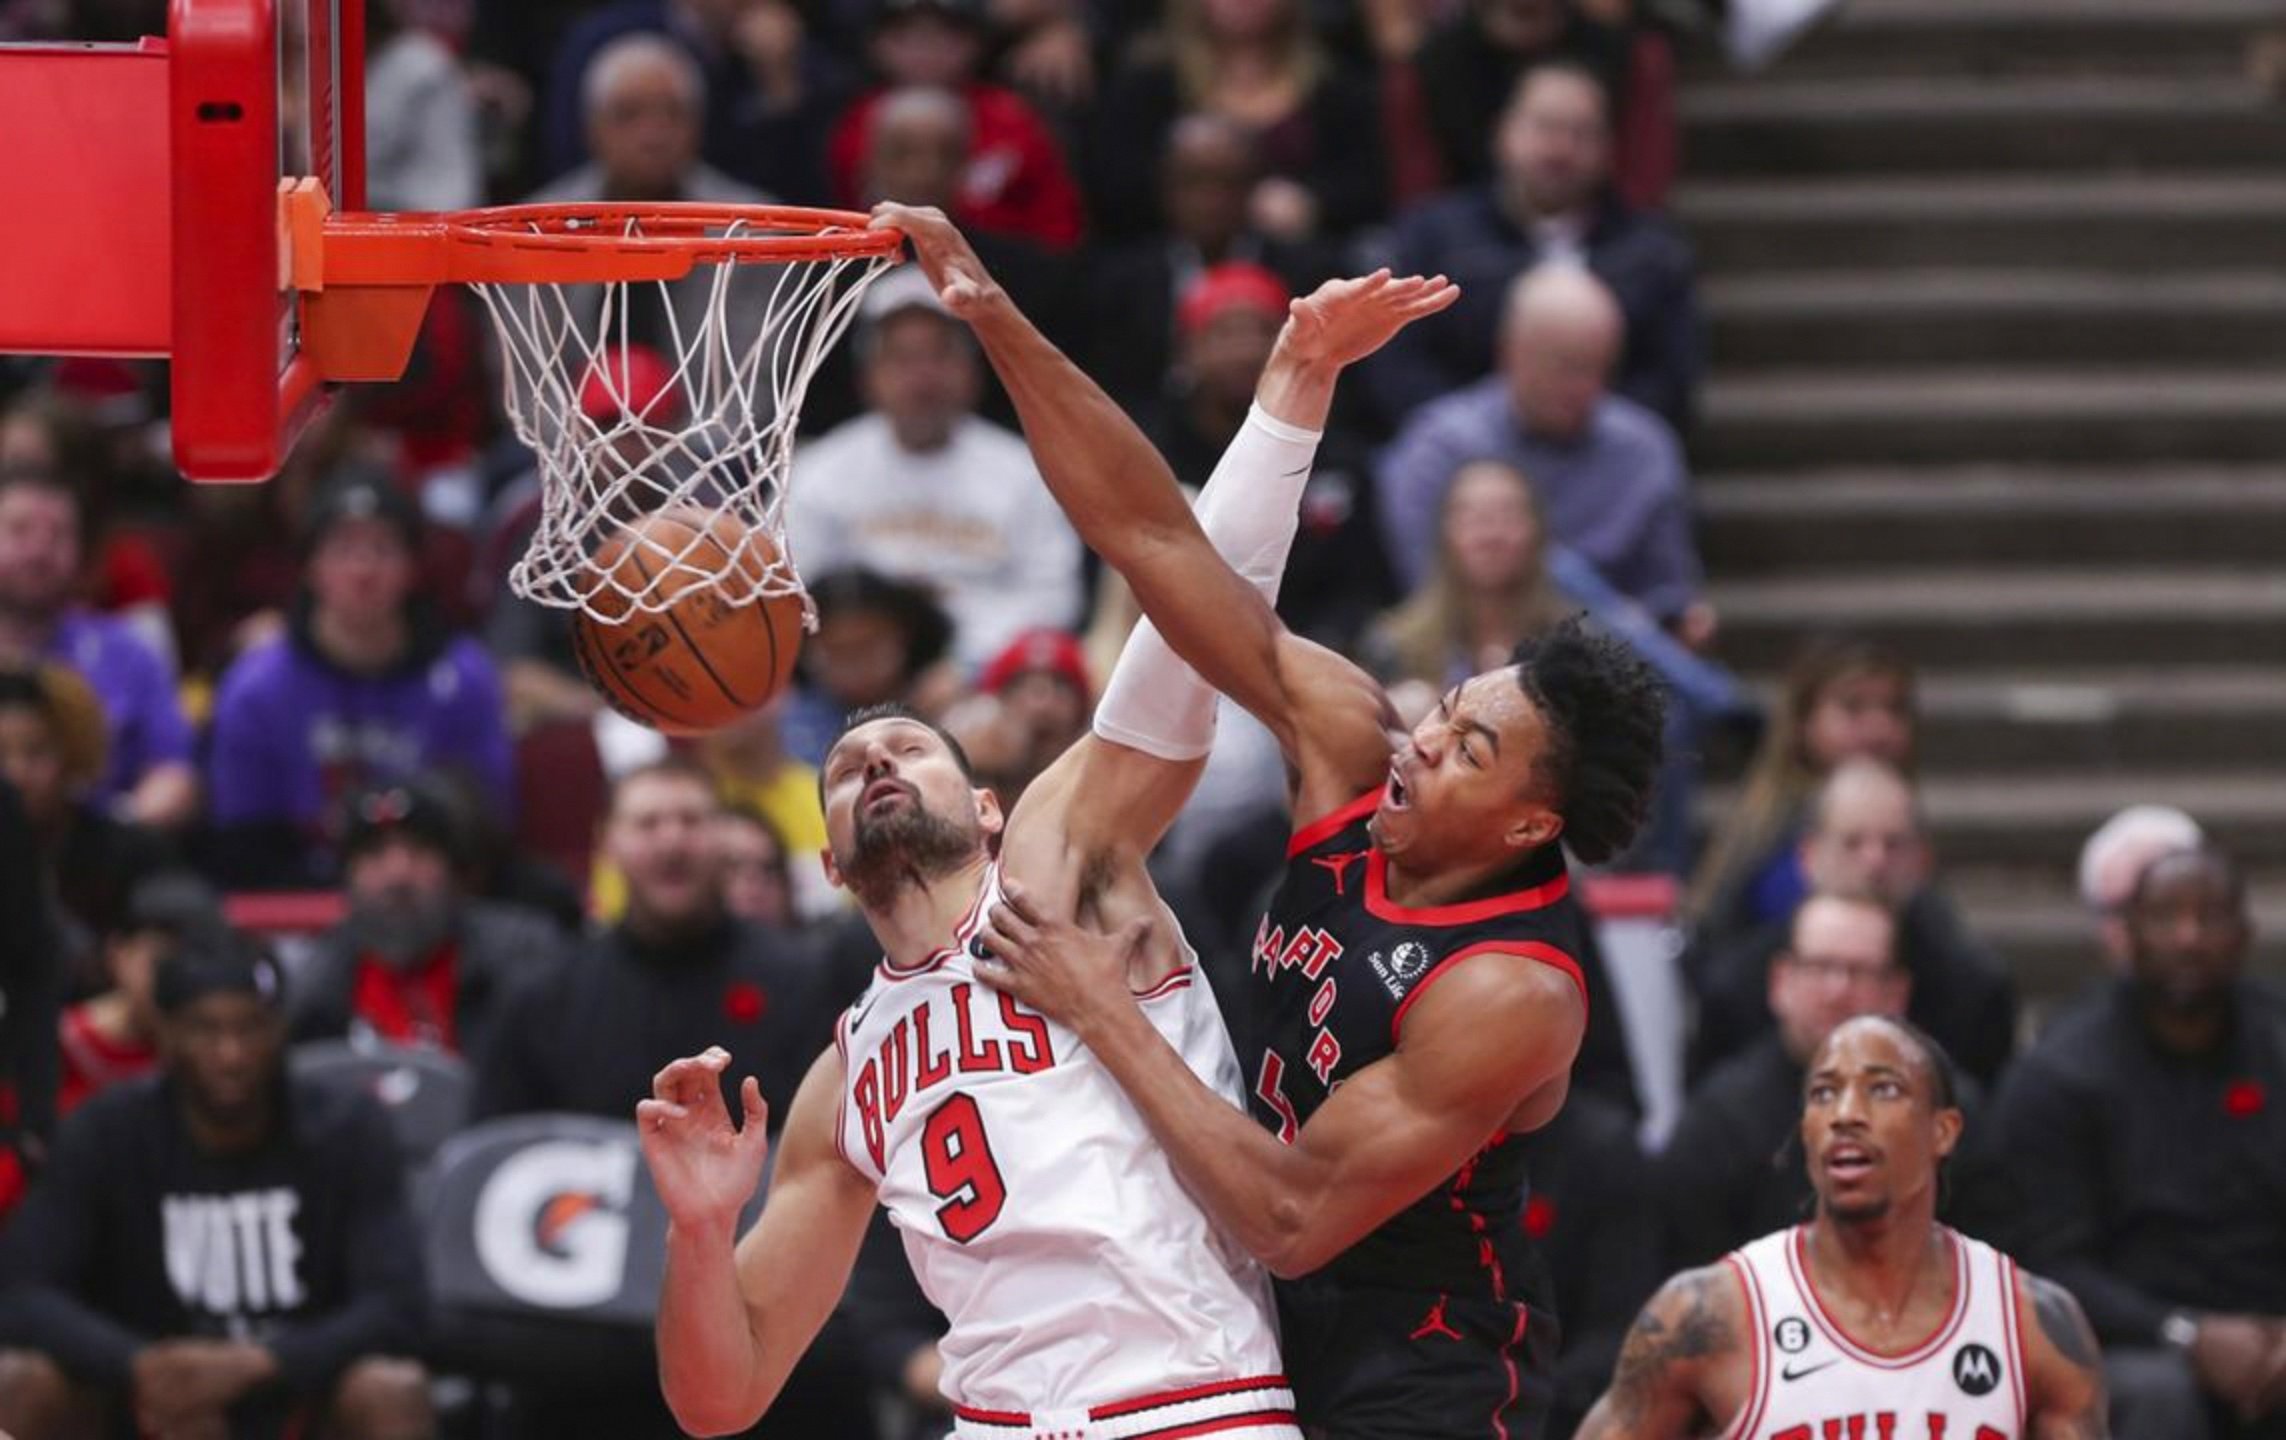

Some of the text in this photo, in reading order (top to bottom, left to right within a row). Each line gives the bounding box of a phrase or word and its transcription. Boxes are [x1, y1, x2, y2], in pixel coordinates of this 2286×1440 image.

[1252, 911, 1345, 1094] RAPTOR
[1367, 951, 1388, 979] Sun
[853, 981, 1056, 1177] BULLS
[474, 1140, 637, 1308] G
[920, 1090, 1007, 1245] 9
[162, 1186, 306, 1314] VOTE
[1779, 1319, 1804, 1351] 6
